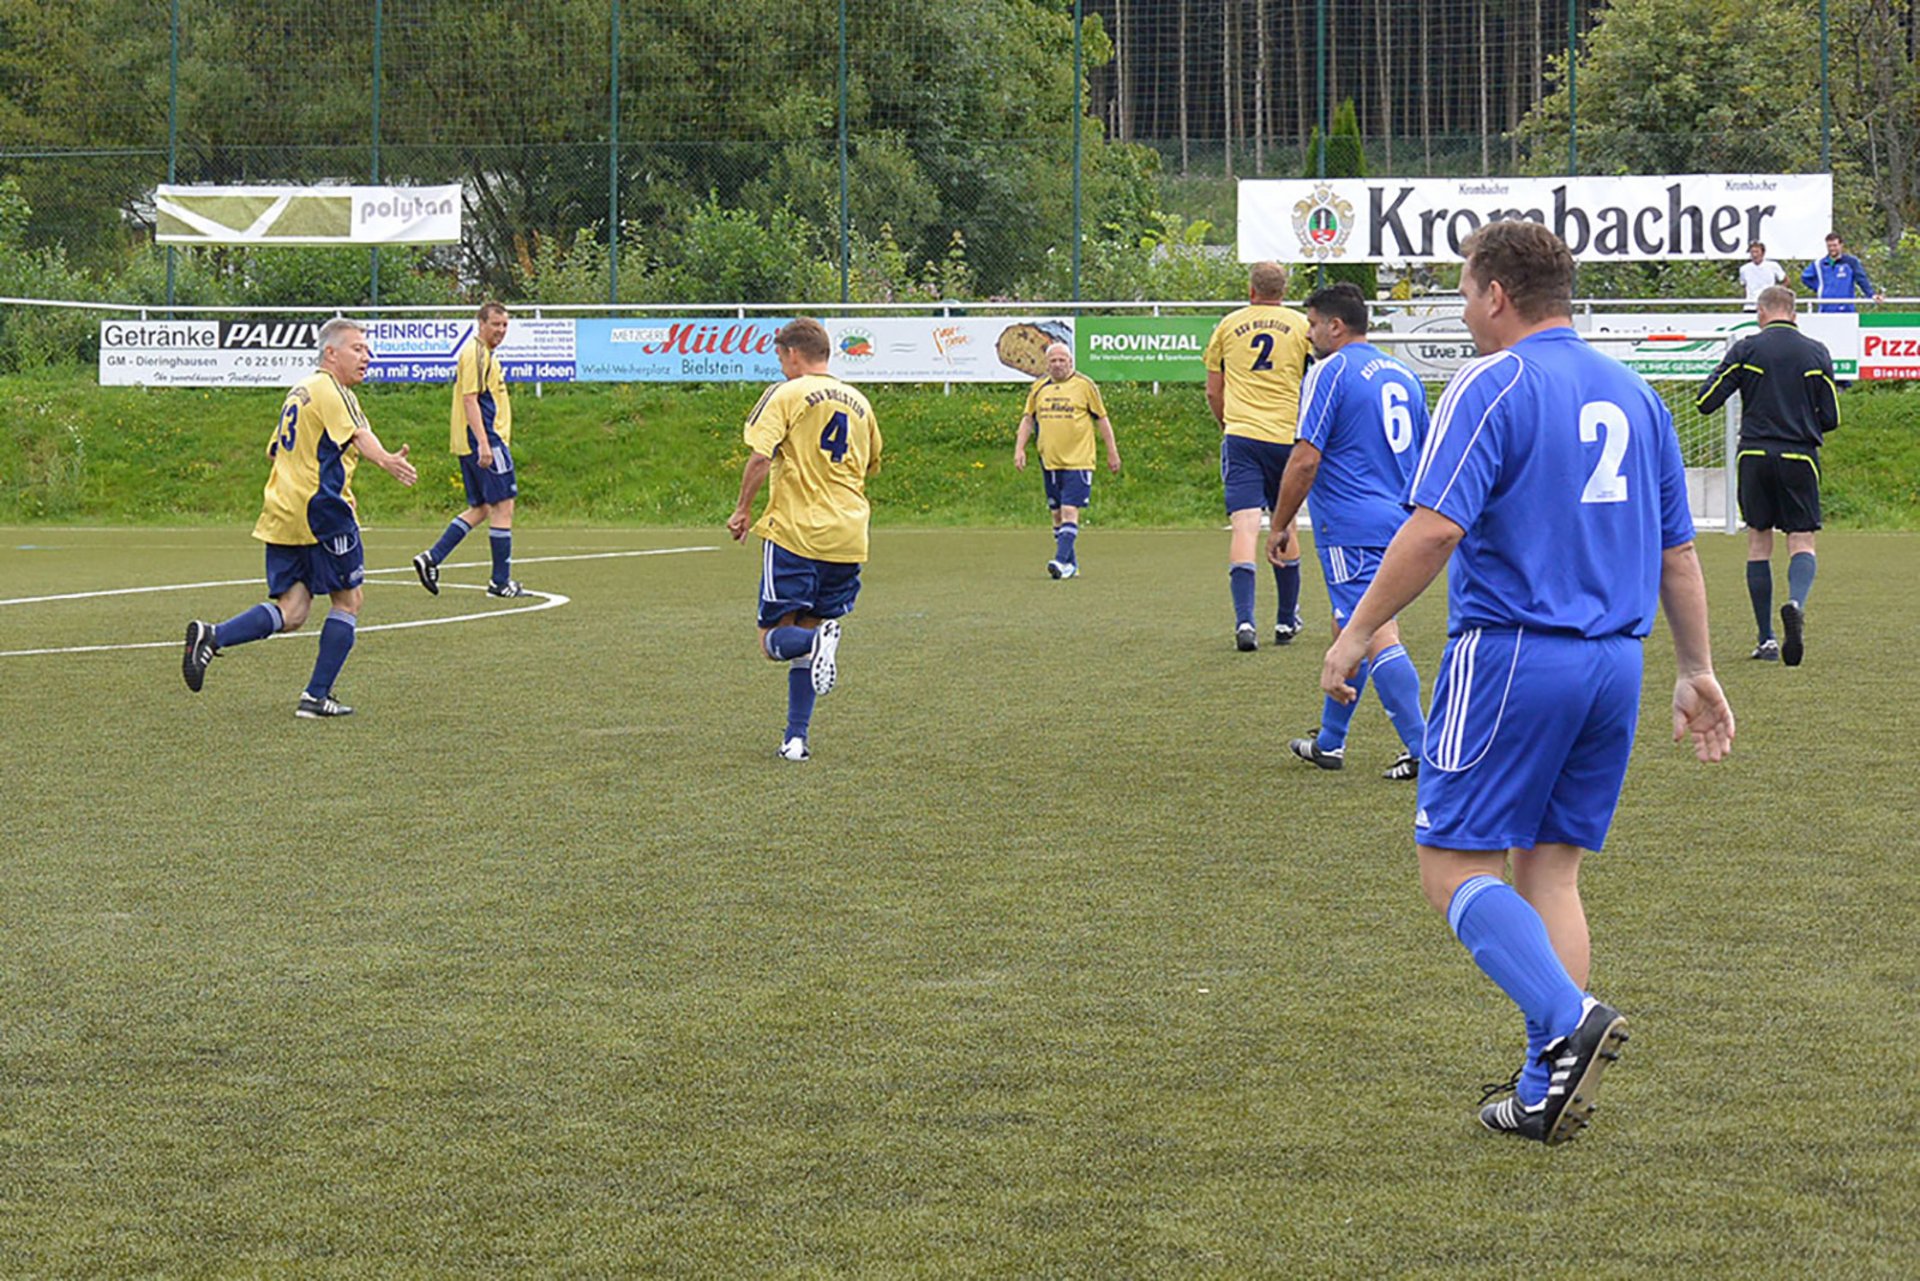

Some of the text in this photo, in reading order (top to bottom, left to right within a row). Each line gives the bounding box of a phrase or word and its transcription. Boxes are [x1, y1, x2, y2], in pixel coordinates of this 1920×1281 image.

[1458, 184, 1509, 195] Krombacher
[1724, 178, 1777, 191] Krombacher
[361, 196, 454, 224] polytan
[104, 325, 215, 347] Getränke
[366, 323, 459, 339] HEINRICHS
[642, 322, 781, 355] Mülle
[373, 341, 451, 352] Haustechnik
[1090, 334, 1202, 351] PROVINZIAL
[1250, 333, 1274, 371] 2
[1418, 345, 1456, 358] Uwe
[107, 356, 126, 366] GM
[136, 356, 217, 369] Dieringhausen
[387, 364, 409, 377] mit
[511, 364, 533, 377] mit
[682, 358, 744, 376] Bielstein
[1381, 381, 1412, 454] 6
[282, 403, 299, 451] 3
[820, 410, 848, 463] 4
[1579, 400, 1629, 503] 2
